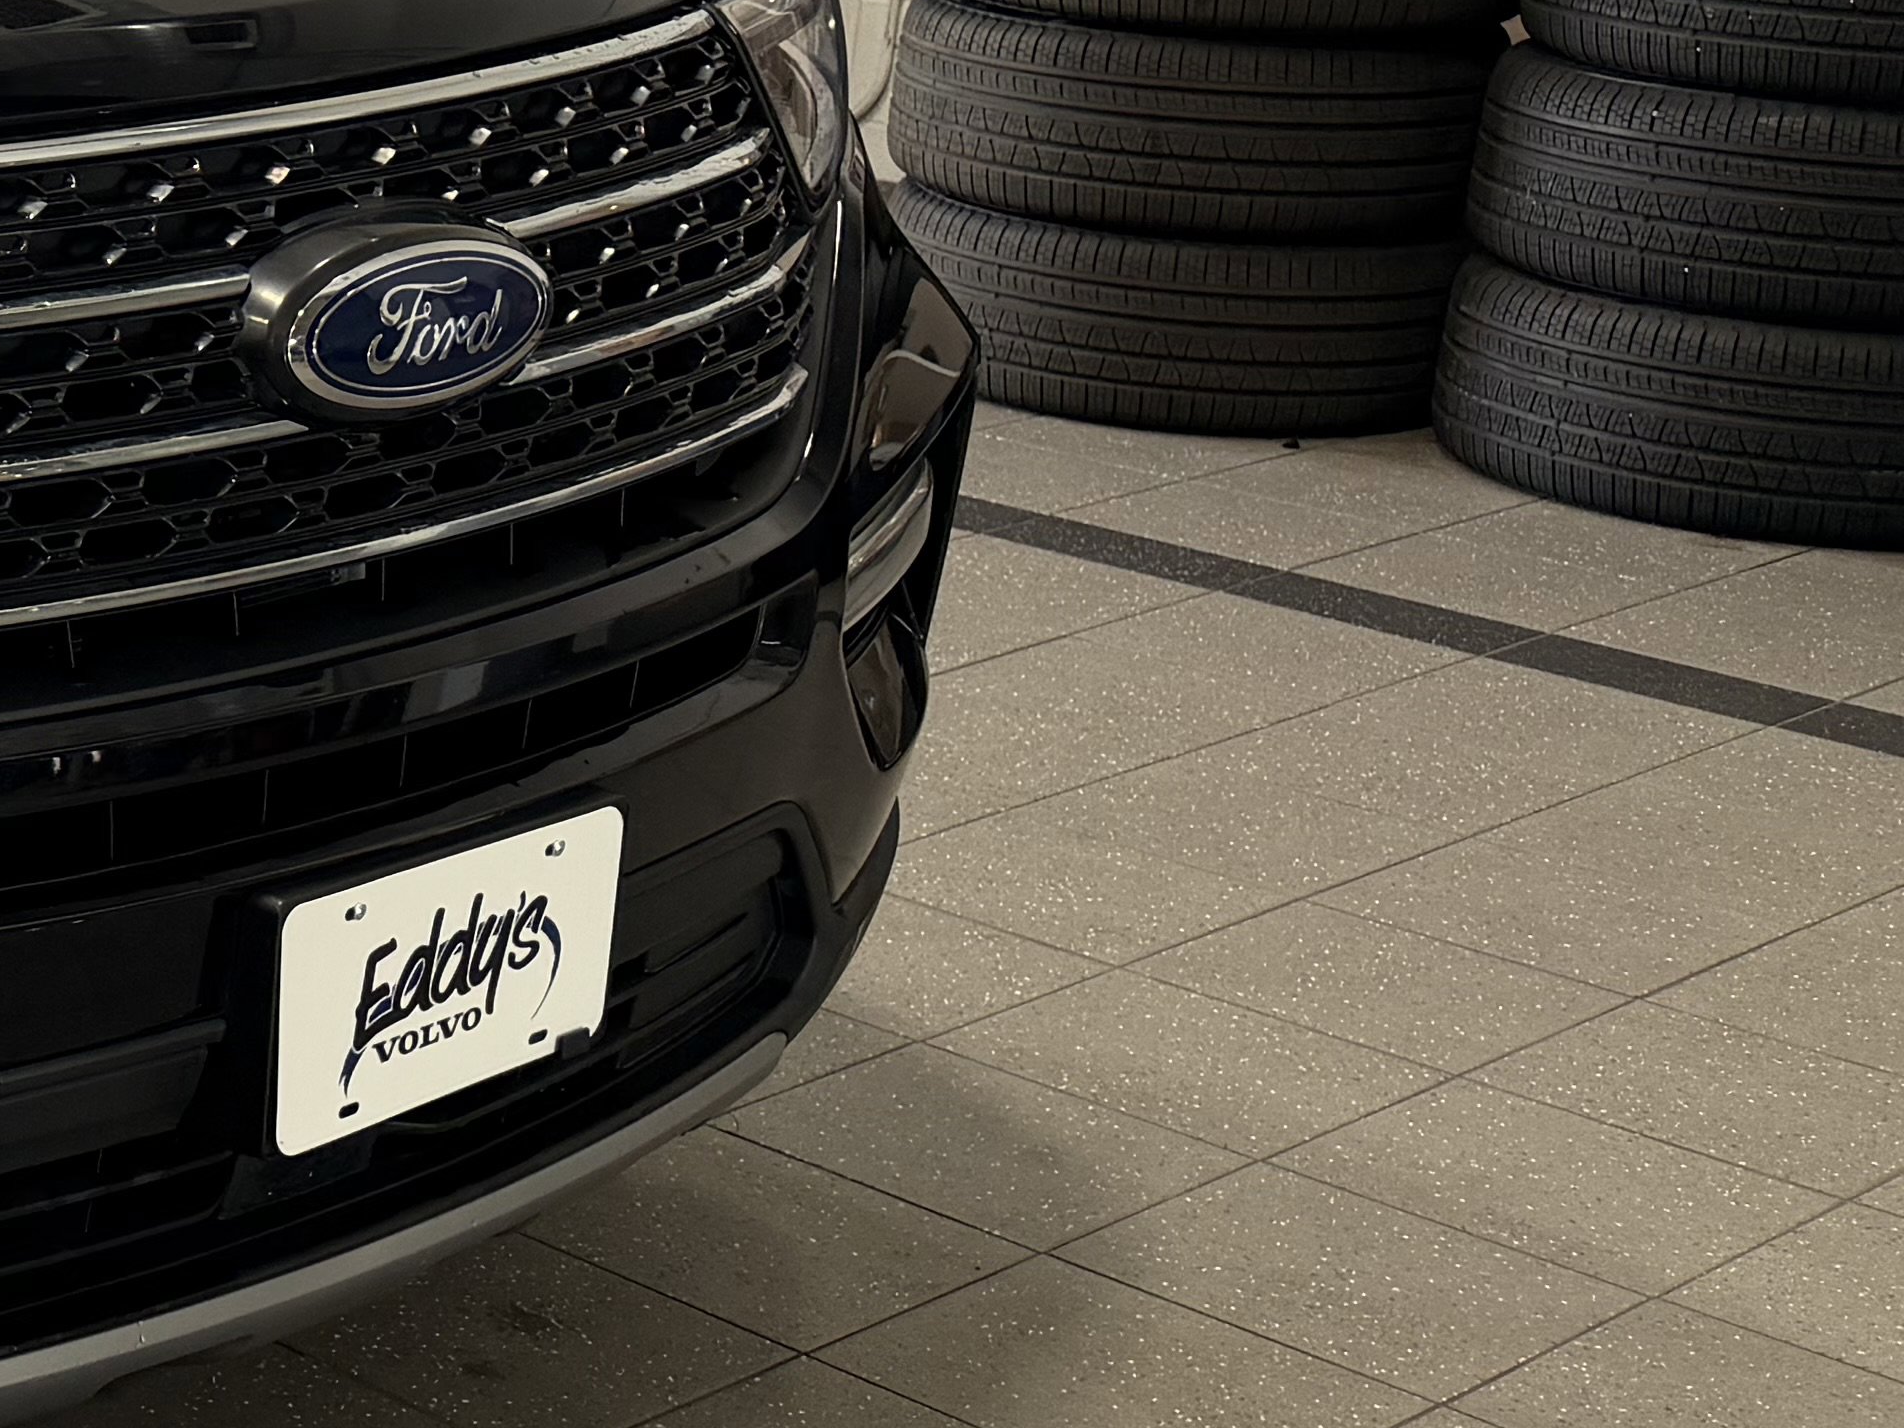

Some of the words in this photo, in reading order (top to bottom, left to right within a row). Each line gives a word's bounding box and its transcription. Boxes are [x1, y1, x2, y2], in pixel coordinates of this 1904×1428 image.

[367, 275, 503, 376] Ford
[352, 890, 549, 1053] Eddy's
[372, 1007, 482, 1064] VOLVO
